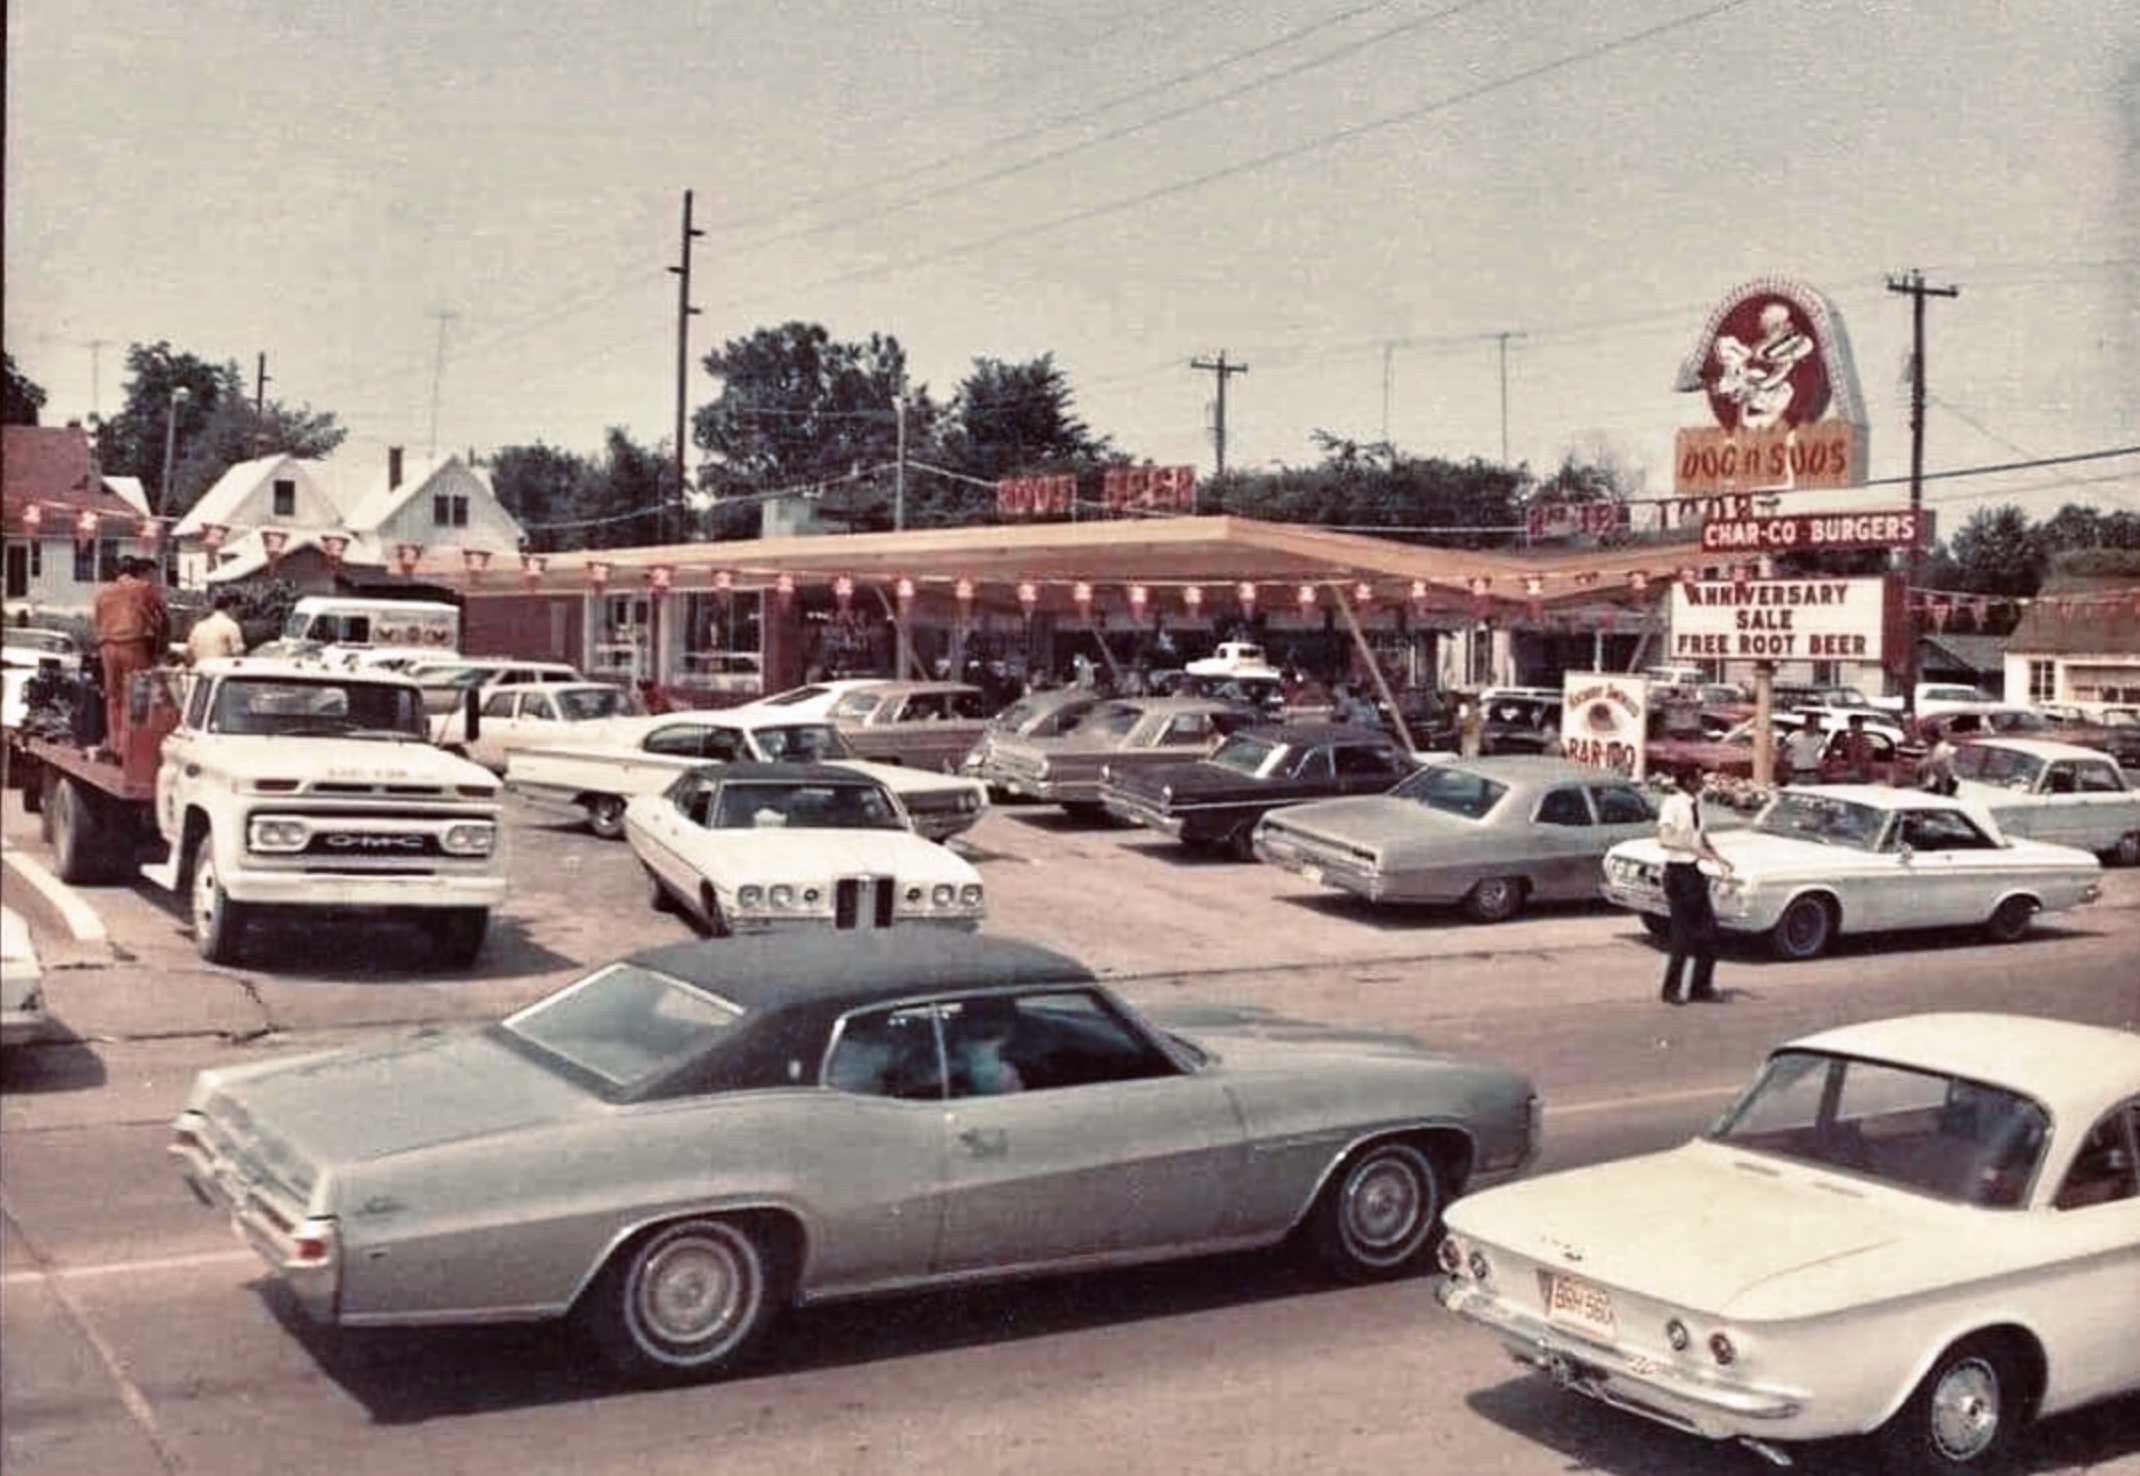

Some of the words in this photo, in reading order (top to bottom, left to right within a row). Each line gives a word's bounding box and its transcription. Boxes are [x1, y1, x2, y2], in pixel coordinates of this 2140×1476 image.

[1704, 522, 1796, 547] CHAR-CO
[1810, 515, 1915, 543] BURGERS
[1685, 583, 1848, 606] ANNIVERSARY
[1736, 609, 1793, 630] SALE
[1678, 635, 1729, 654] FREE
[1739, 635, 1795, 654] ROOT
[1809, 634, 1866, 655] BEER
[326, 833, 424, 849] GMC
